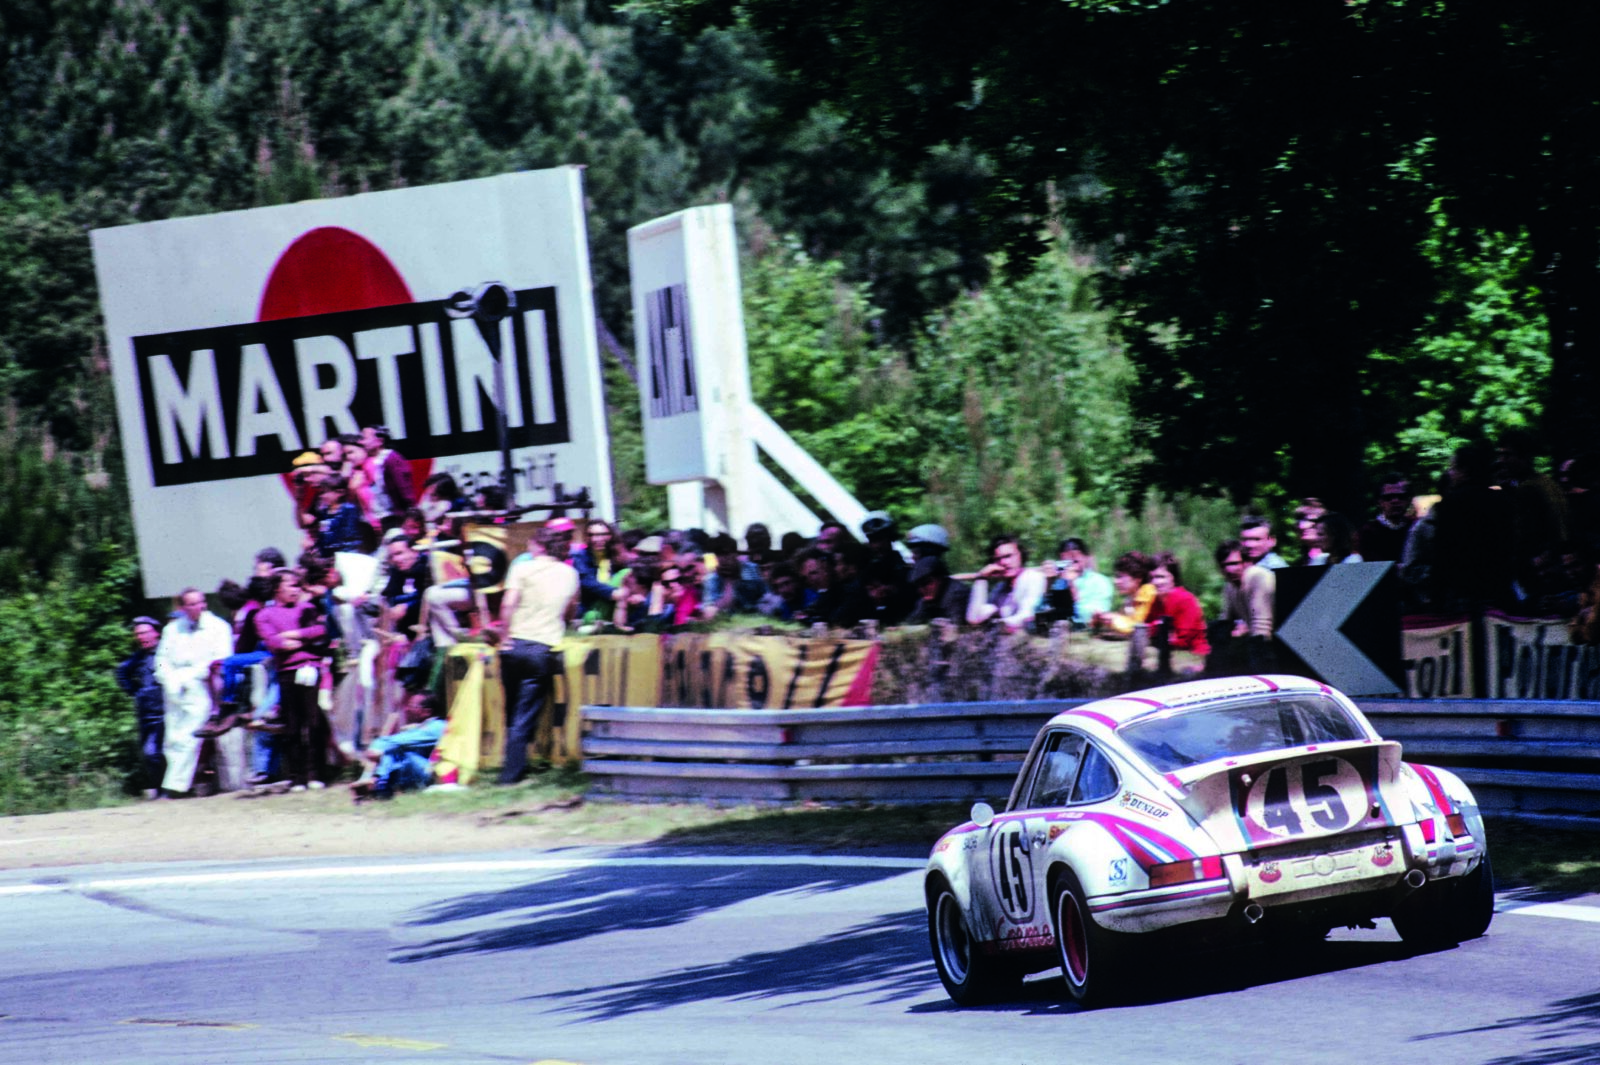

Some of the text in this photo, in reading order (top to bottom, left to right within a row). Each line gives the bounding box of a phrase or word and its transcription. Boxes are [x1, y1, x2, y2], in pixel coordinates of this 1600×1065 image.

[148, 308, 557, 466] MARTINI
[1129, 797, 1170, 819] DUNLOP
[1262, 758, 1351, 836] 45
[998, 831, 1030, 913] 45
